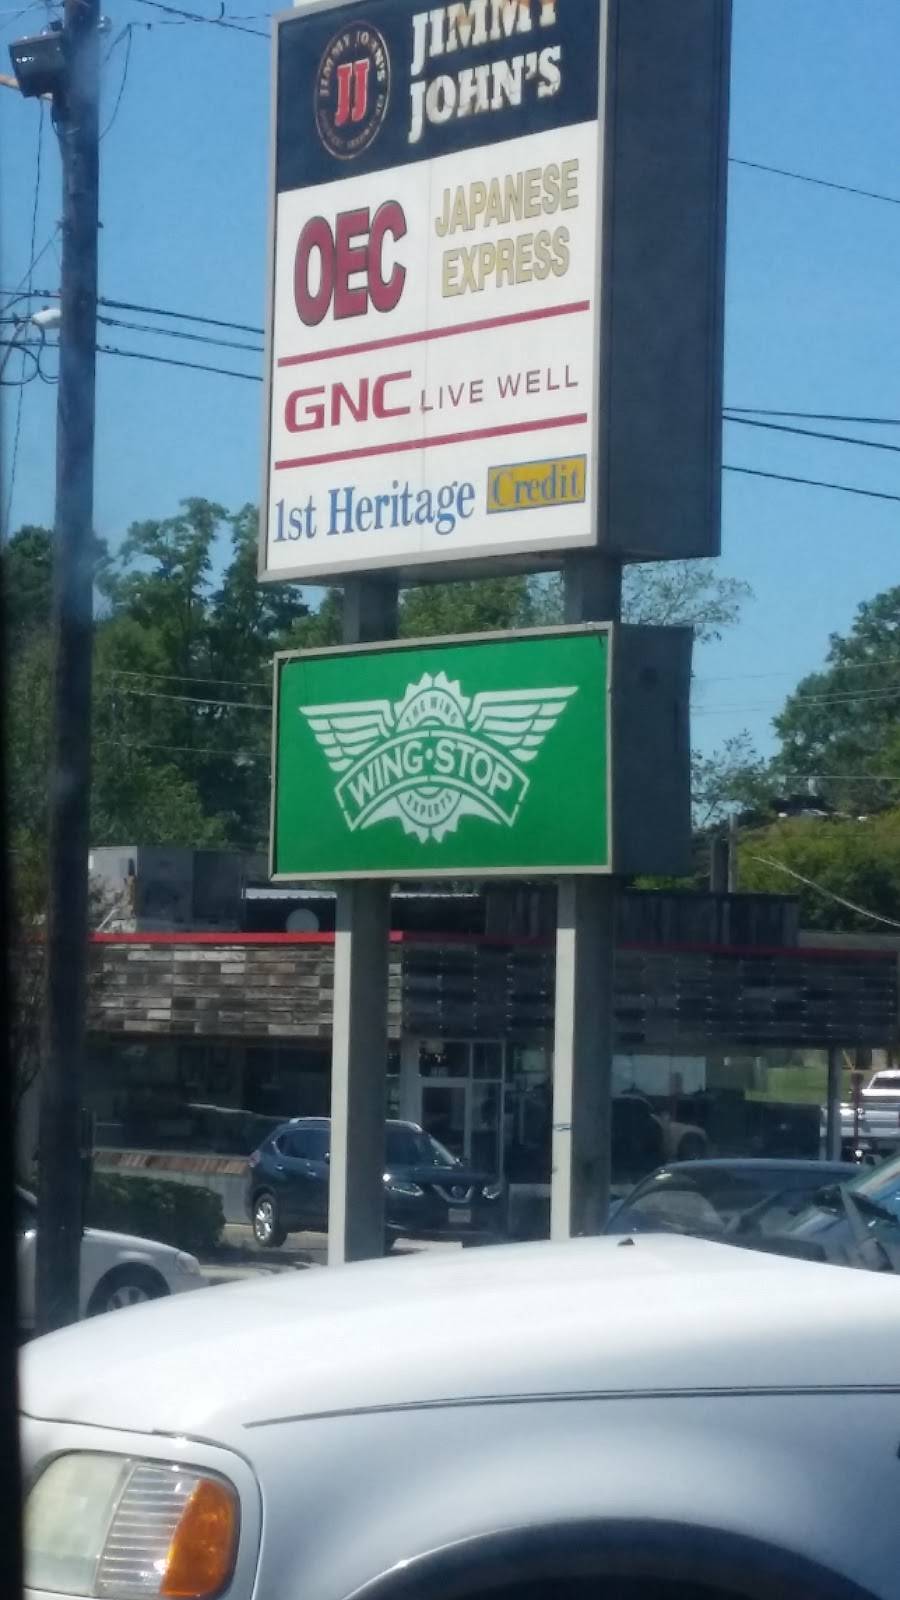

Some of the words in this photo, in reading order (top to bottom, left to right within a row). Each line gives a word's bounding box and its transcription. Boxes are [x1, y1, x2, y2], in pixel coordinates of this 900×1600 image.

[334, 58, 371, 128] JJ
[408, 46, 562, 144] JOHN'S
[435, 158, 579, 238] JAPANESE
[294, 200, 407, 327] OEC
[442, 226, 570, 298] EXPRESS
[284, 370, 412, 433] GNC
[420, 379, 484, 414] LIVE
[497, 364, 578, 399] WELL
[272, 495, 317, 543] 1st
[326, 479, 475, 536] Heritage
[491, 462, 582, 507] Credit
